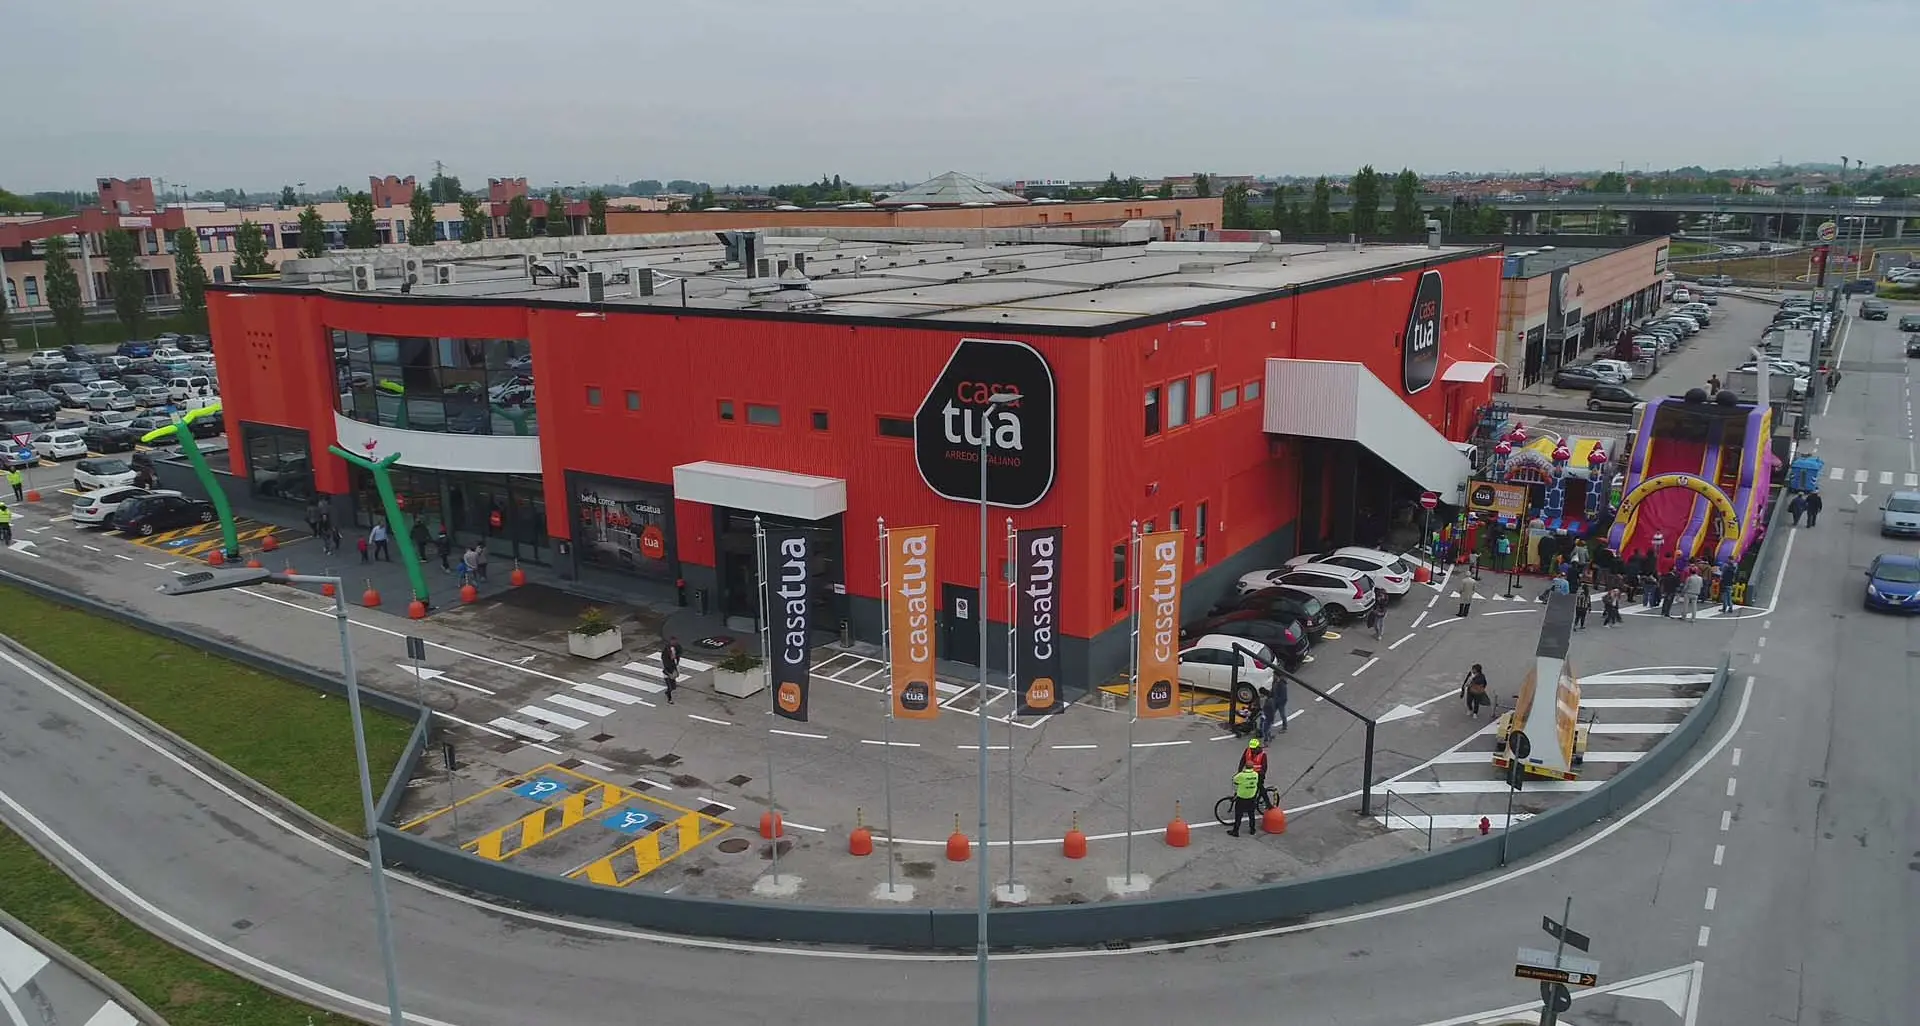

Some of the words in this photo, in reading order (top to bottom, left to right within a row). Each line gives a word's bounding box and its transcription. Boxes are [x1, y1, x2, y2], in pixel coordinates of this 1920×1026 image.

[1414, 318, 1434, 351] tua
[942, 398, 1023, 451] tua
[945, 450, 979, 462] ARREDO
[1475, 492, 1490, 500] tua
[635, 504, 661, 514] casatua
[644, 537, 659, 548] tua
[776, 537, 807, 664] casatua
[897, 535, 929, 663] casatua
[1025, 535, 1055, 660] casatua
[1148, 540, 1177, 663] casatua
[702, 637, 725, 647] tua
[906, 691, 924, 701] tua
[1032, 689, 1049, 699] tua
[1151, 691, 1167, 700] tua
